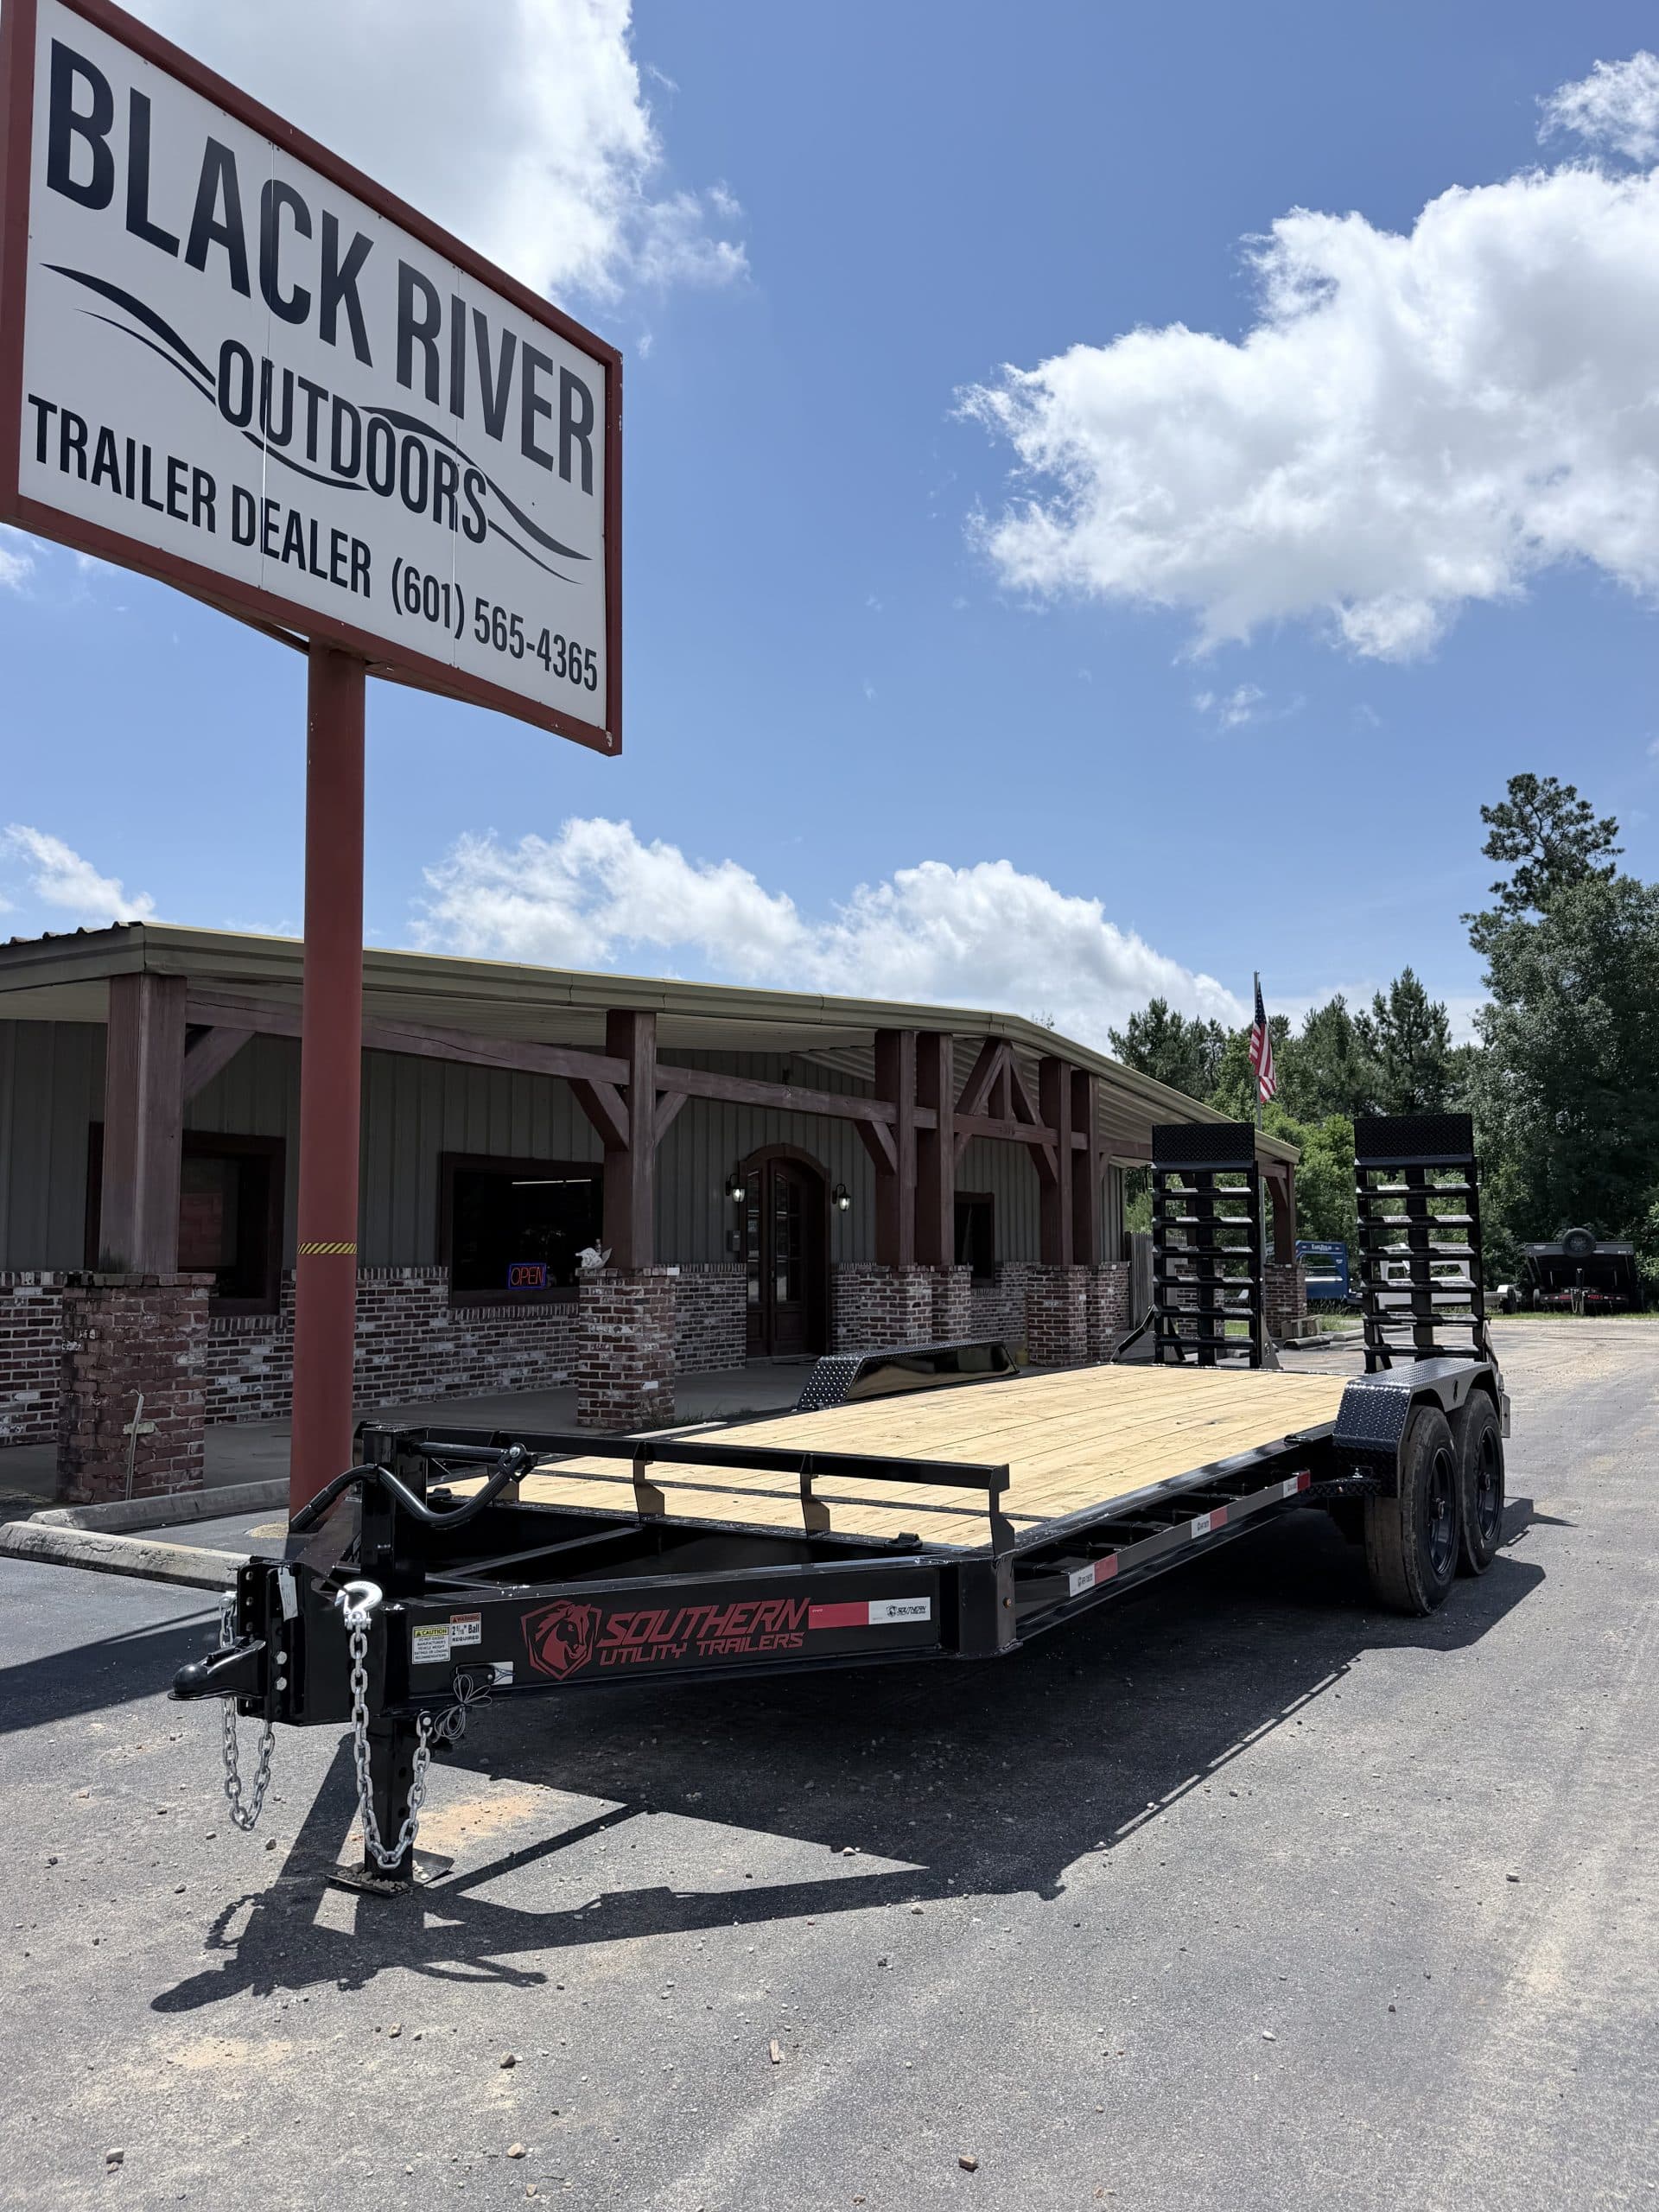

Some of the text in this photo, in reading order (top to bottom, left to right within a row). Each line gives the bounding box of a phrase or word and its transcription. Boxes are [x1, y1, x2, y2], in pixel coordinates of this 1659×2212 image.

[46, 37, 595, 496] BLACK RIVER
[217, 339, 487, 544] OUTDOORS
[28, 393, 599, 692] TRAILER DEALER (601) 565-4365
[511, 1266, 543, 1286] OPEN
[468, 1624, 480, 1633] Ball
[595, 1598, 811, 1648] SOUTHERN
[600, 1632, 805, 1667] UTILITY TRAILERS
